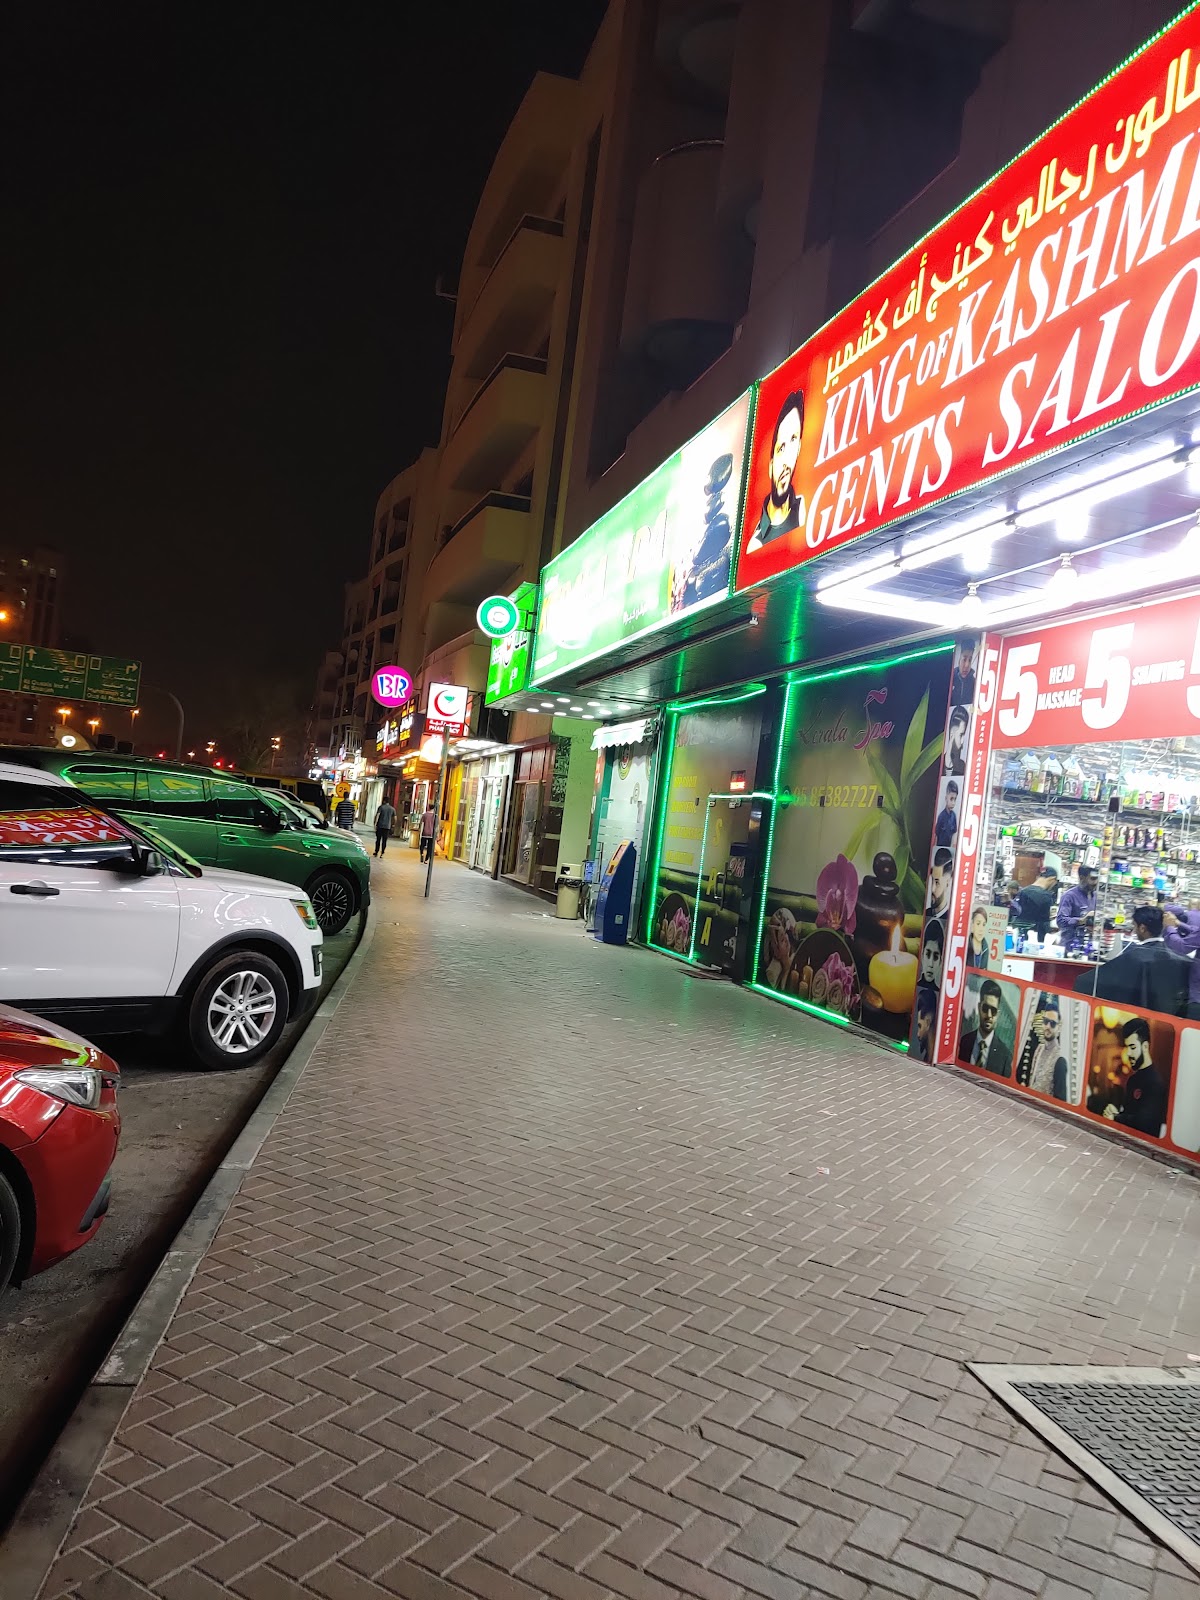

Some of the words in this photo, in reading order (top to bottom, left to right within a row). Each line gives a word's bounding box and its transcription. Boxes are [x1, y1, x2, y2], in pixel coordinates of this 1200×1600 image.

[1105, 48, 1200, 174] الون
[1001, 143, 1098, 256] رجالي
[925, 210, 995, 323] كينج
[822, 297, 889, 395] كشمير
[814, 334, 918, 468] KING
[916, 327, 954, 386] OF
[806, 396, 966, 549] GENTS
[377, 674, 409, 698] BR
[978, 648, 998, 713] 5
[998, 641, 1042, 737] 5
[1036, 687, 1083, 711] MASSAGE
[1048, 663, 1076, 686] HEAD
[1081, 622, 1136, 730] 5
[853, 687, 895, 756] Spa
[962, 793, 982, 857] 5
[945, 935, 966, 999] 5
[990, 938, 999, 961] 5
[943, 1003, 953, 1046] SHAVING
